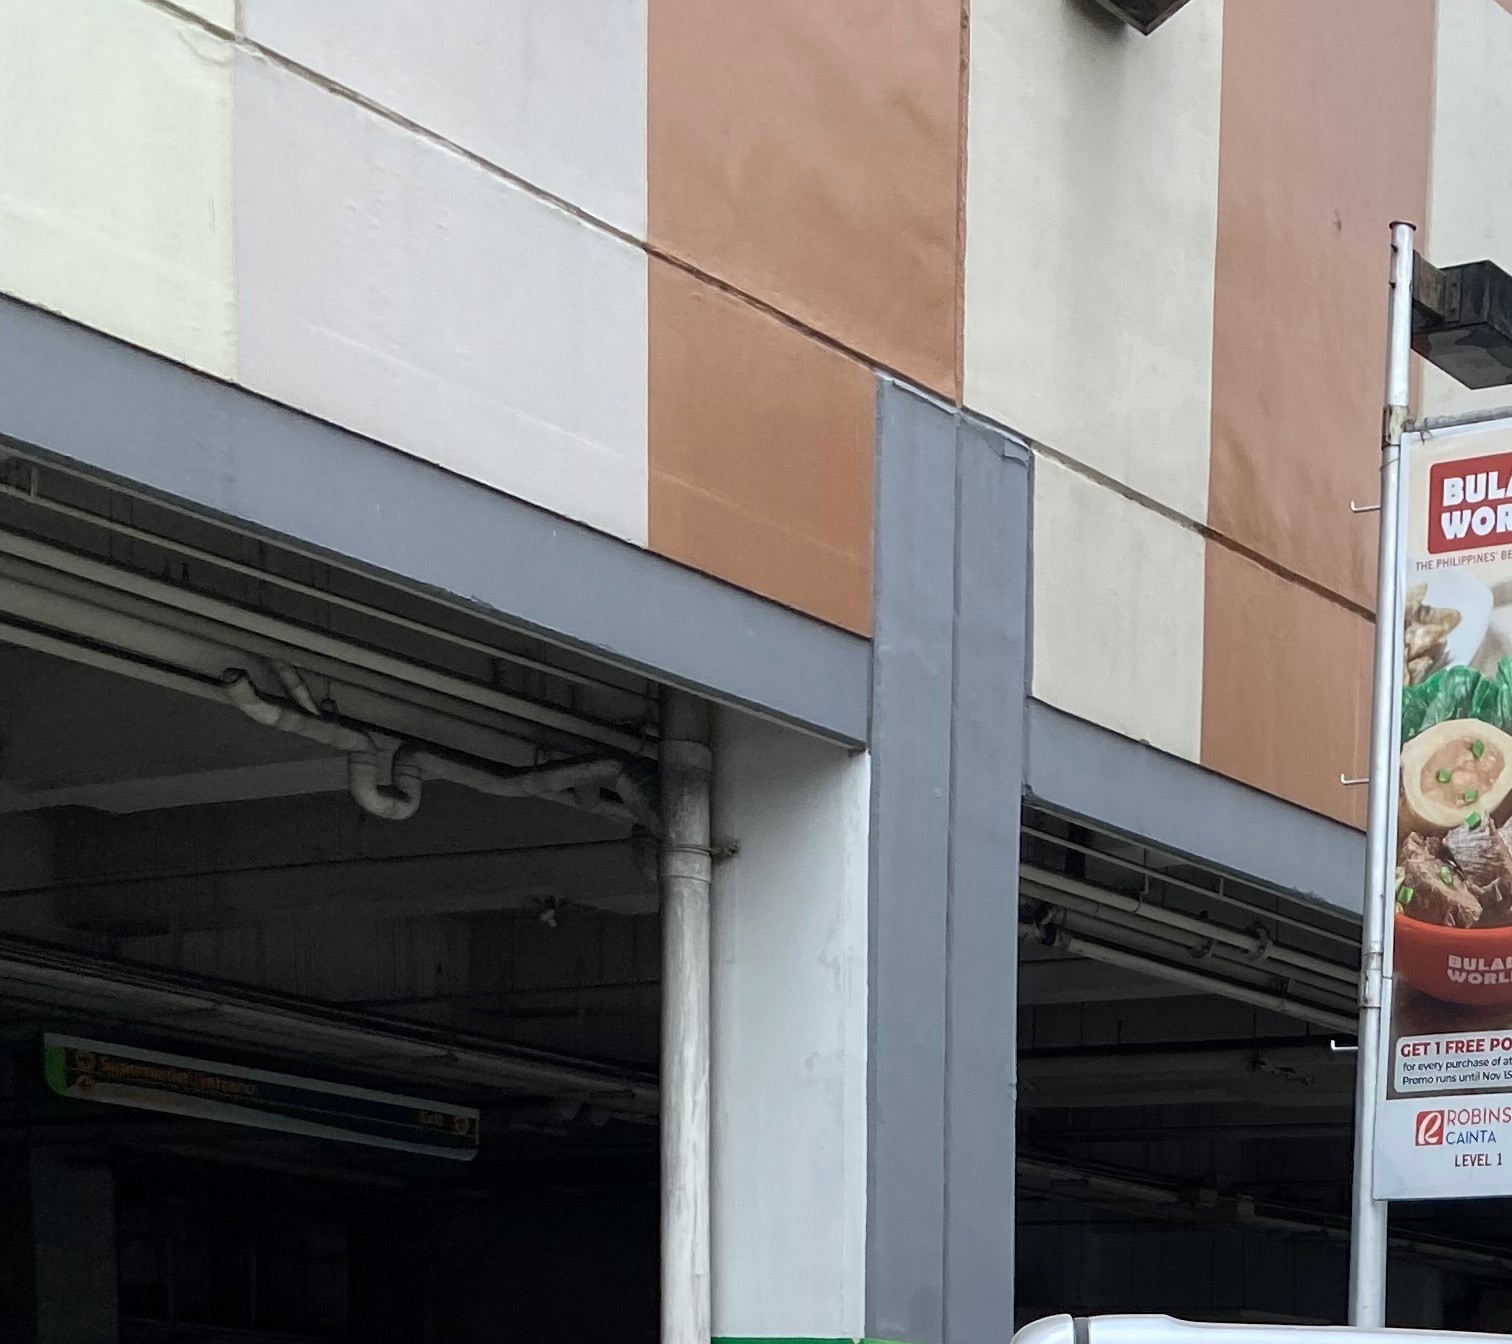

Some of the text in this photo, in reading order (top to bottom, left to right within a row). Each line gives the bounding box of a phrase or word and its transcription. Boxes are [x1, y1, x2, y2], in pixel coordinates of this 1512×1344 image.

[1416, 558, 1433, 572] THE
[1400, 1042, 1431, 1058] GET
[1435, 1041, 1441, 1055] 1
[1445, 1038, 1486, 1055] FREE
[1402, 1062, 1416, 1072] for
[1418, 1061, 1443, 1072] every
[1446, 1057, 1489, 1072] purchase
[1491, 1056, 1502, 1066] of
[1503, 1056, 1512, 1066] at
[1402, 1070, 1512, 1086] Promo runs until Nov 15
[1446, 1130, 1497, 1145] CAINTA
[1454, 1152, 1503, 1168] LEVEL 1
